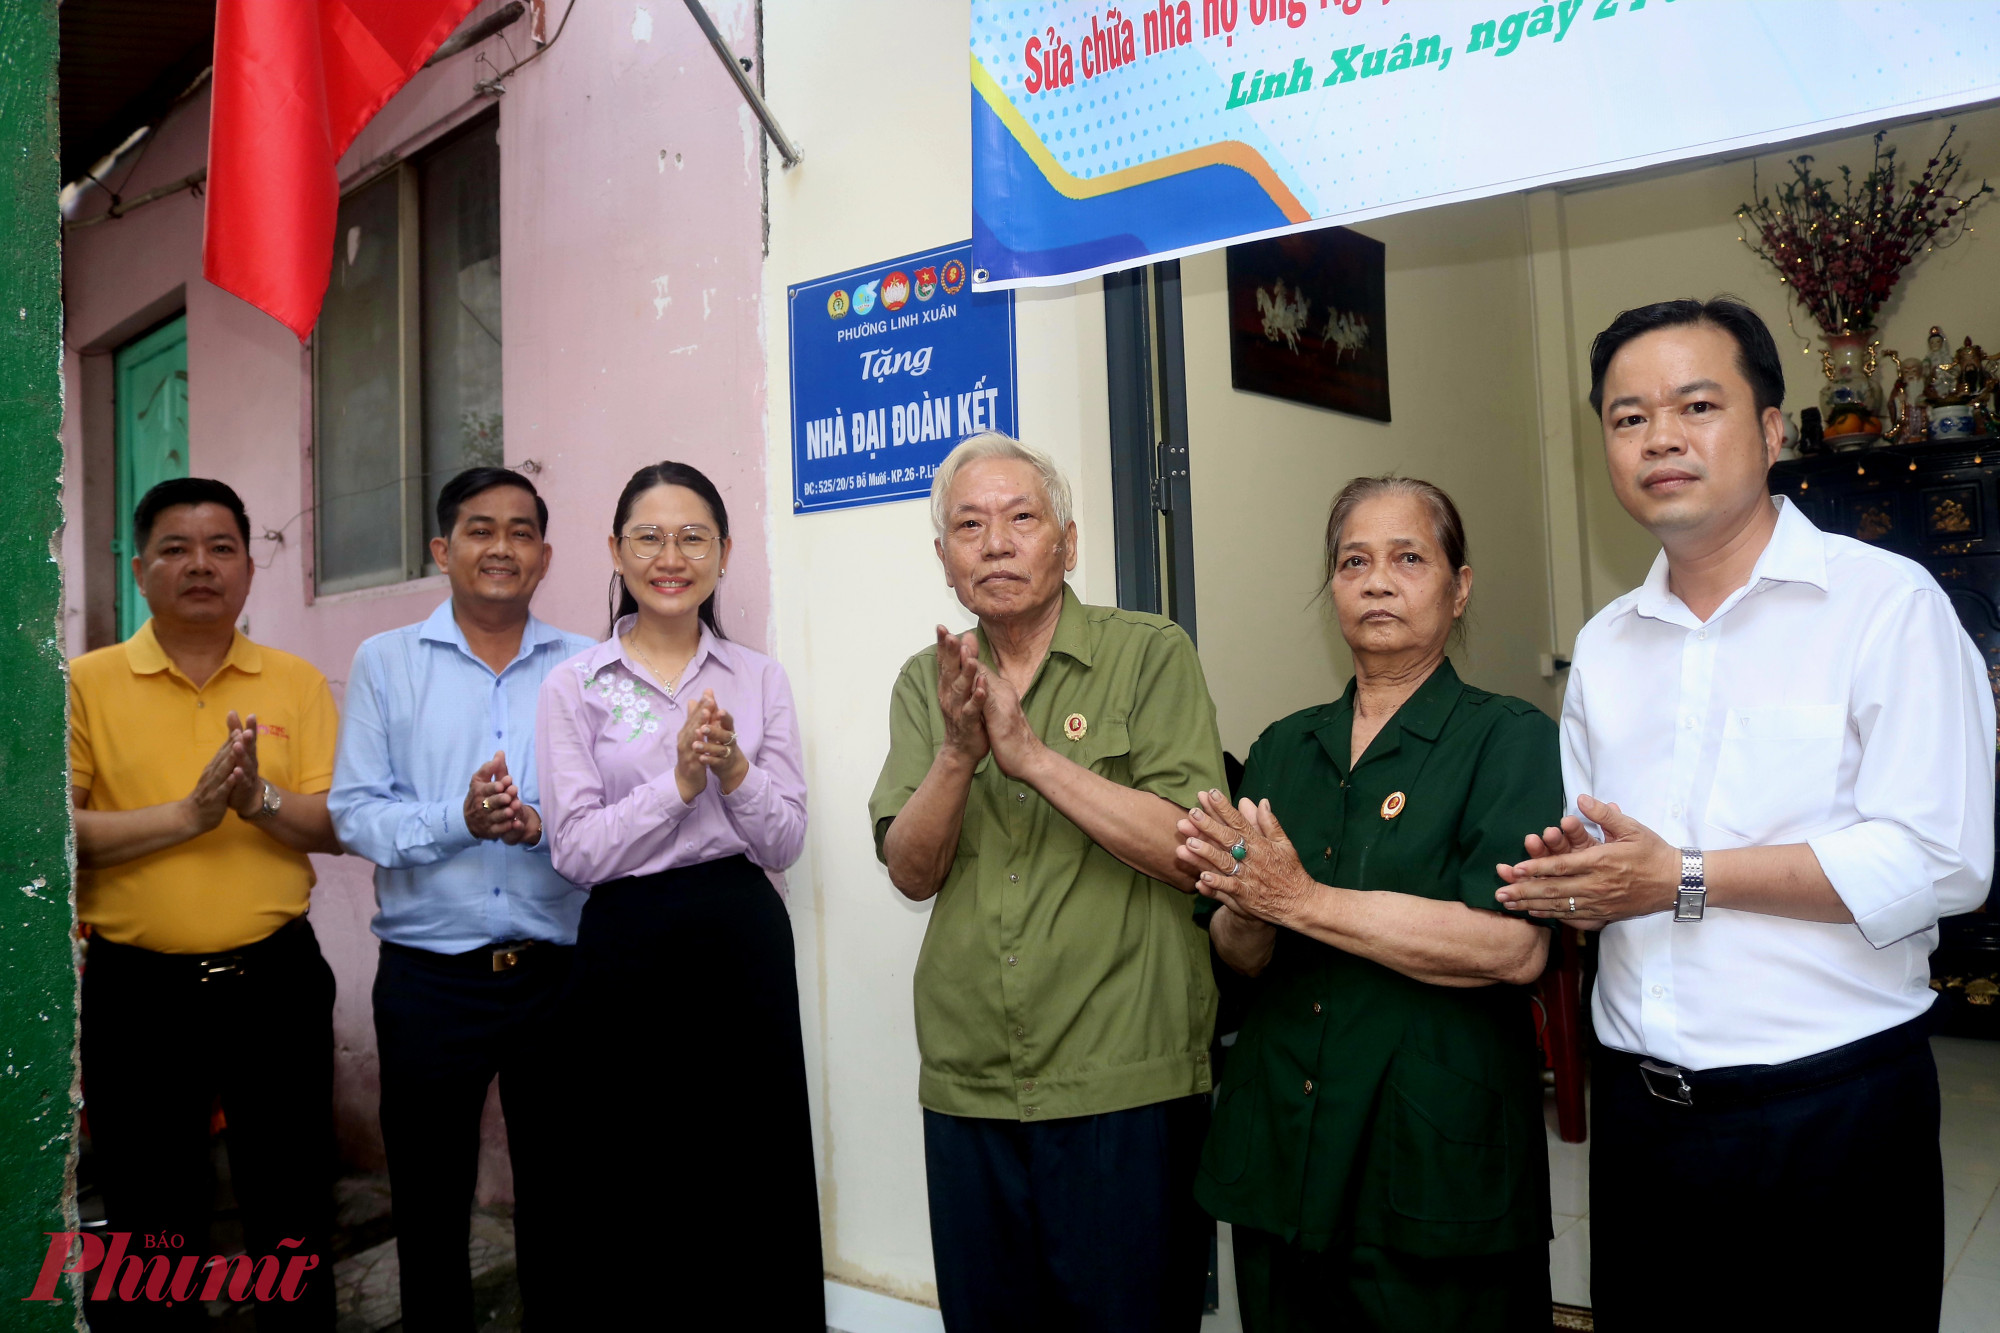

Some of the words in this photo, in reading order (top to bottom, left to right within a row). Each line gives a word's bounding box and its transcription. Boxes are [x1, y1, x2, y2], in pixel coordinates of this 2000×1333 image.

[1024, 26, 1074, 94] Sửa
[1081, 7, 1136, 79] chữa
[1225, 57, 1313, 110] Linh
[1322, 33, 1452, 88] Xuân,
[837, 320, 887, 342] PHƯỜNG
[890, 313, 918, 330] LINH
[922, 304, 957, 324] XUÂN
[859, 346, 934, 383] Tặng
[806, 408, 847, 460] NHÀ
[852, 408, 886, 460] ĐẠI
[892, 391, 950, 447] ĐOÀN
[957, 375, 998, 436] KẾT
